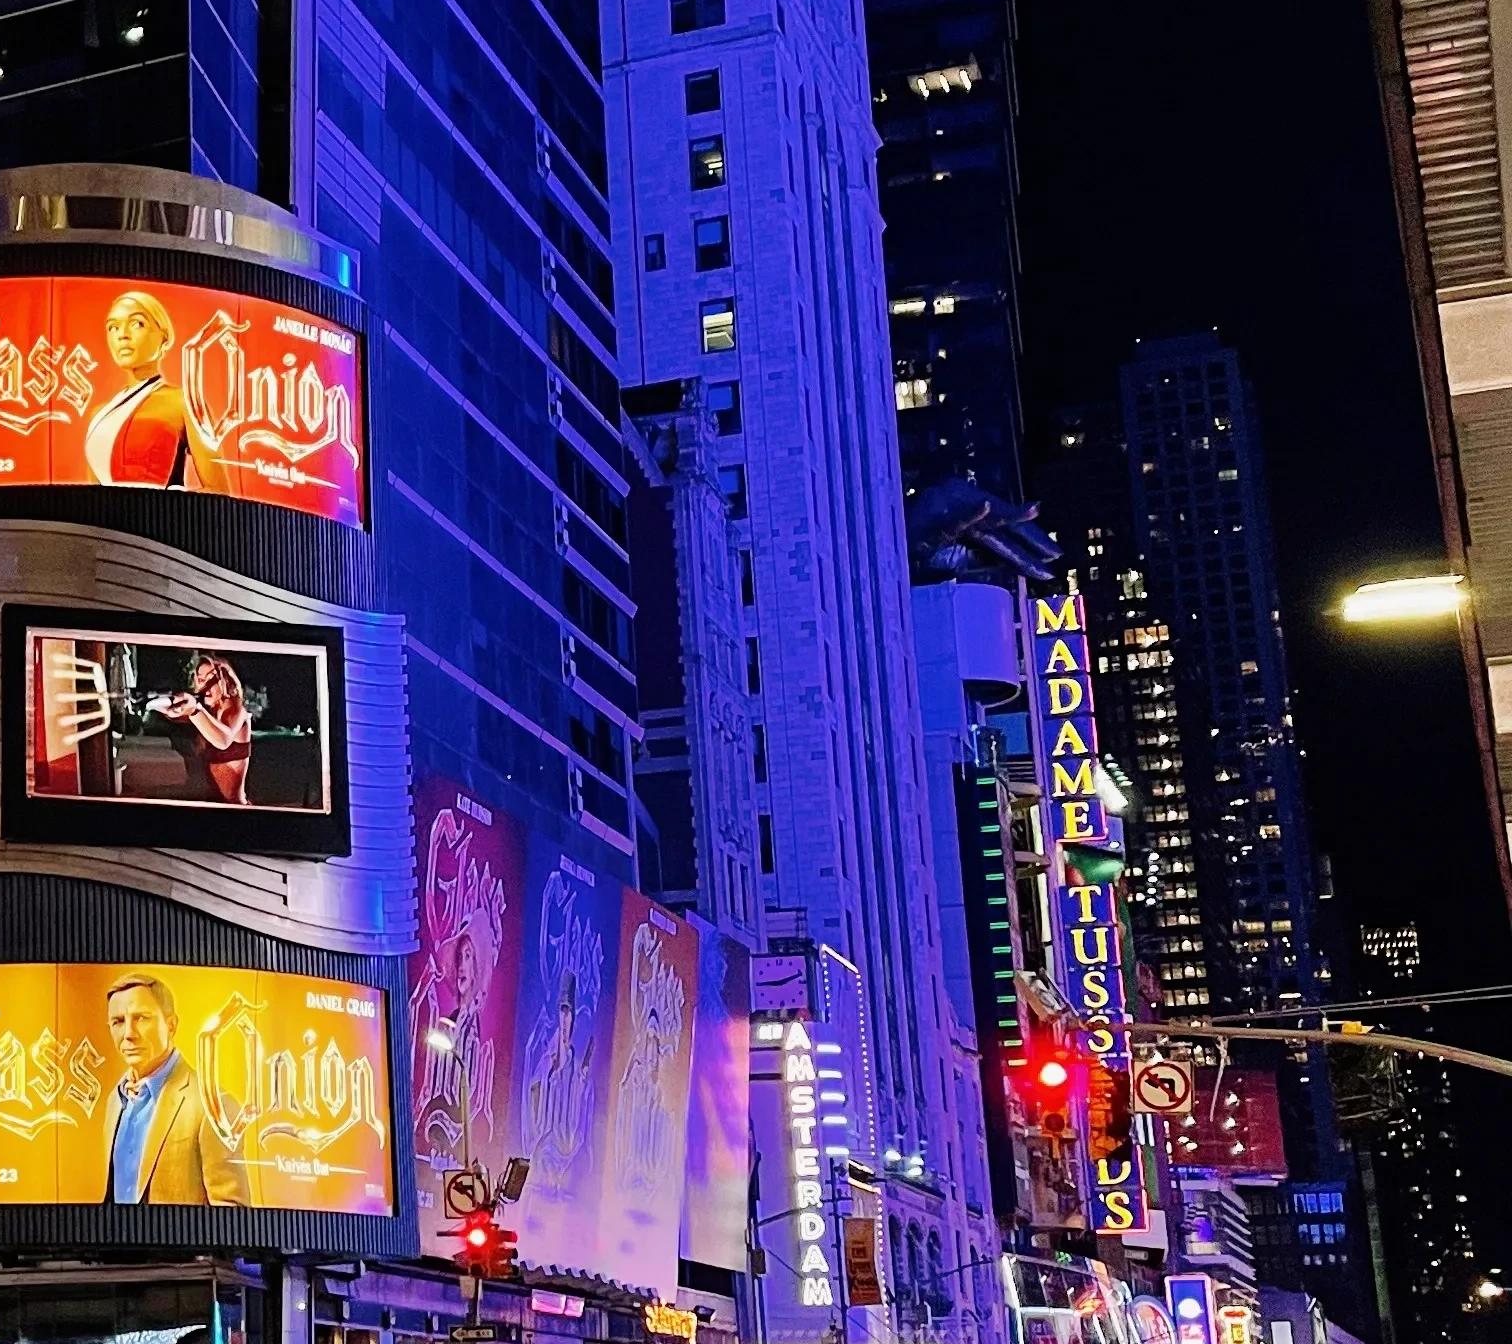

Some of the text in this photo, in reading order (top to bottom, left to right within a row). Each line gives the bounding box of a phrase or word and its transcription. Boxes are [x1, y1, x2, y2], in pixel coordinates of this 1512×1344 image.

[1035, 595, 1096, 840] MADAME
[786, 1021, 834, 1307] AMSTERDAM
[1068, 884, 1134, 1230] TUSSDS
